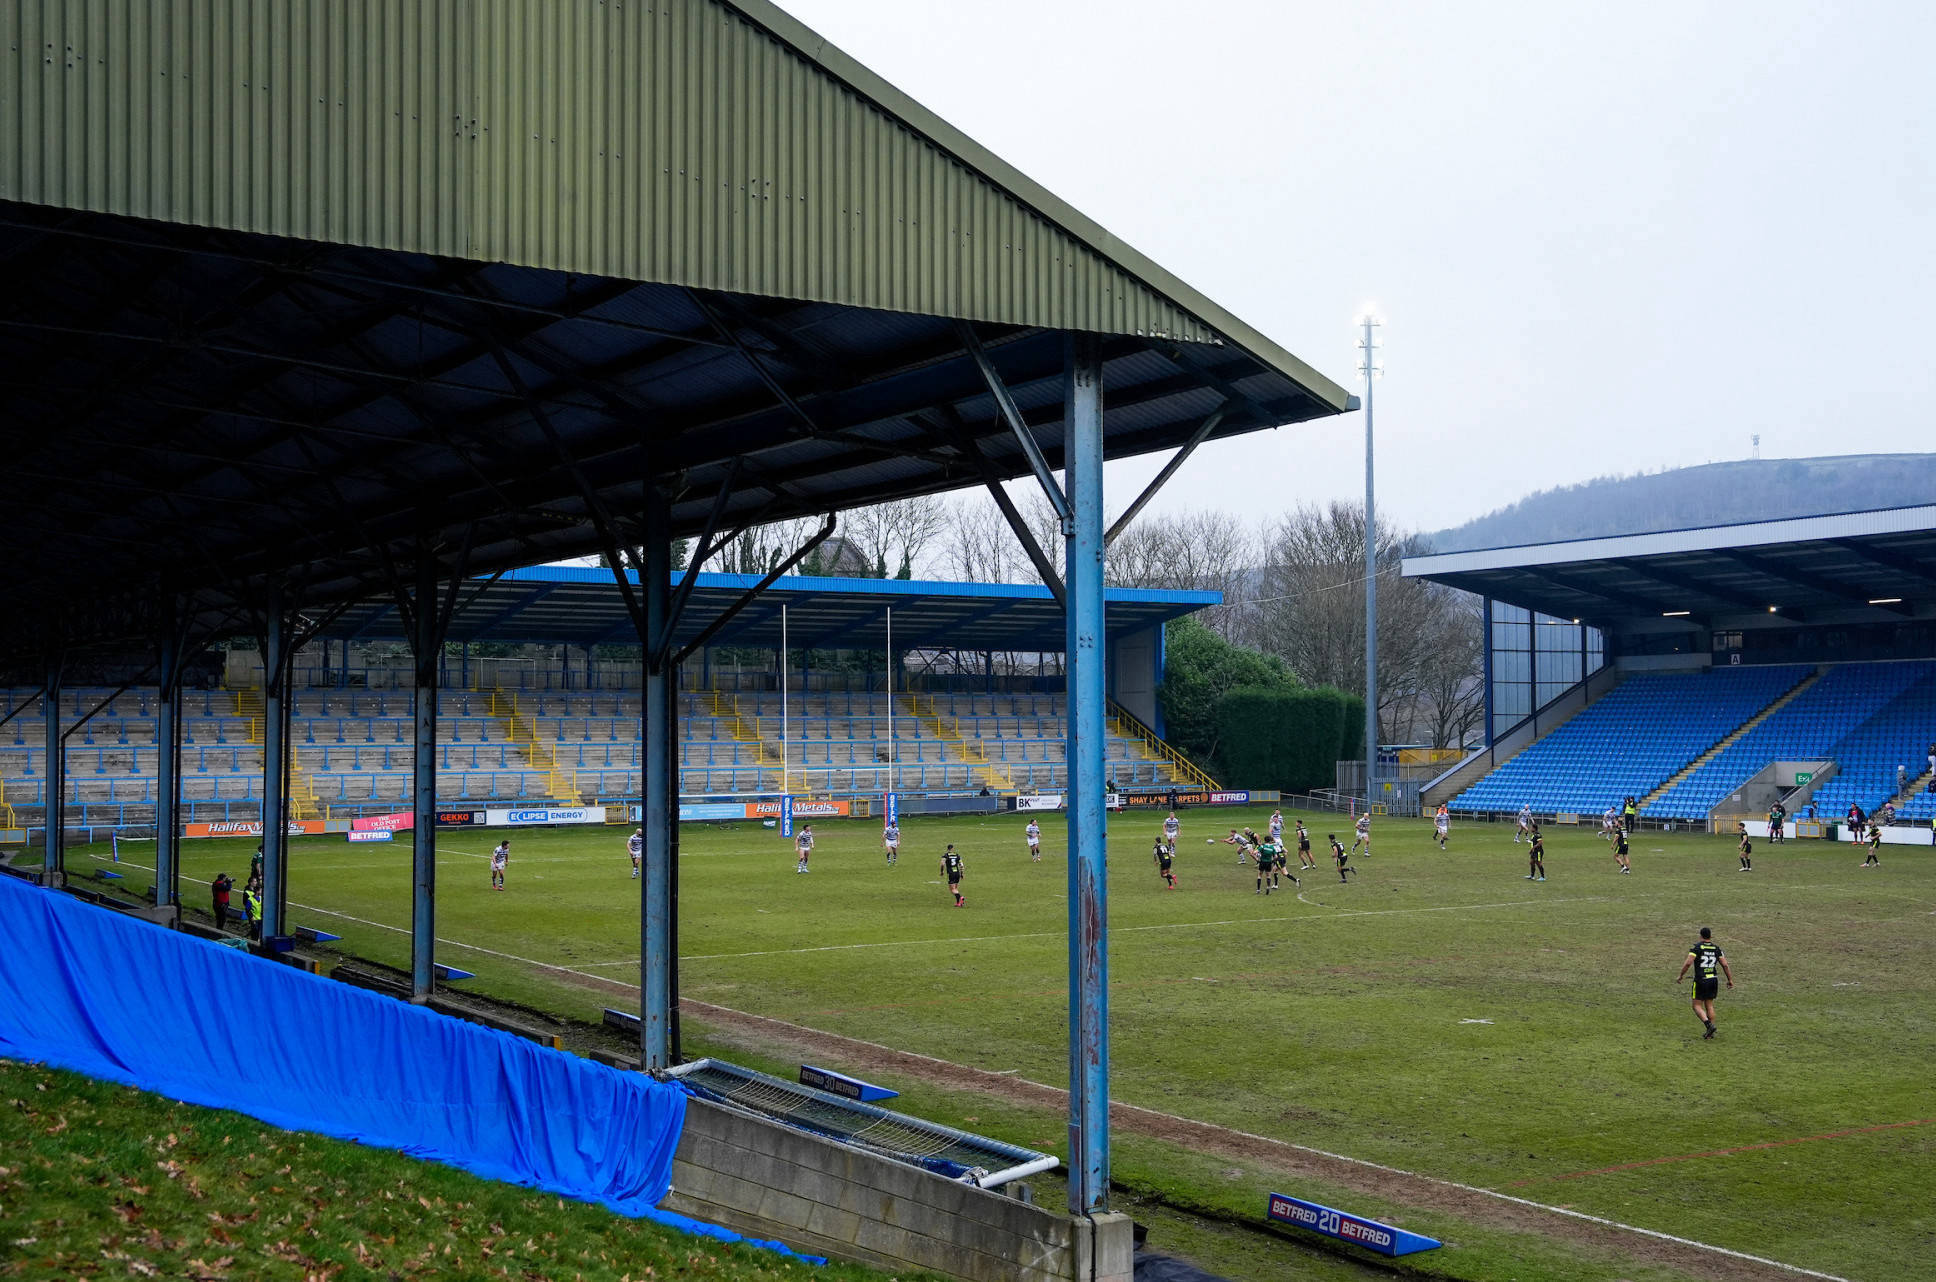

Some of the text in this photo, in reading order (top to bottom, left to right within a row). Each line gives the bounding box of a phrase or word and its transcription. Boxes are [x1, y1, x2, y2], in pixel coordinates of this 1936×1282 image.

[1129, 796, 1147, 804] SHAY
[1211, 793, 1246, 802] BETFRED
[440, 813, 469, 821] GEKKO
[350, 832, 390, 840] BETFRED
[1700, 956, 1717, 968] 22
[824, 1076, 835, 1090] 30
[1272, 1201, 1391, 1246] BETFRED 20 BETFRED
